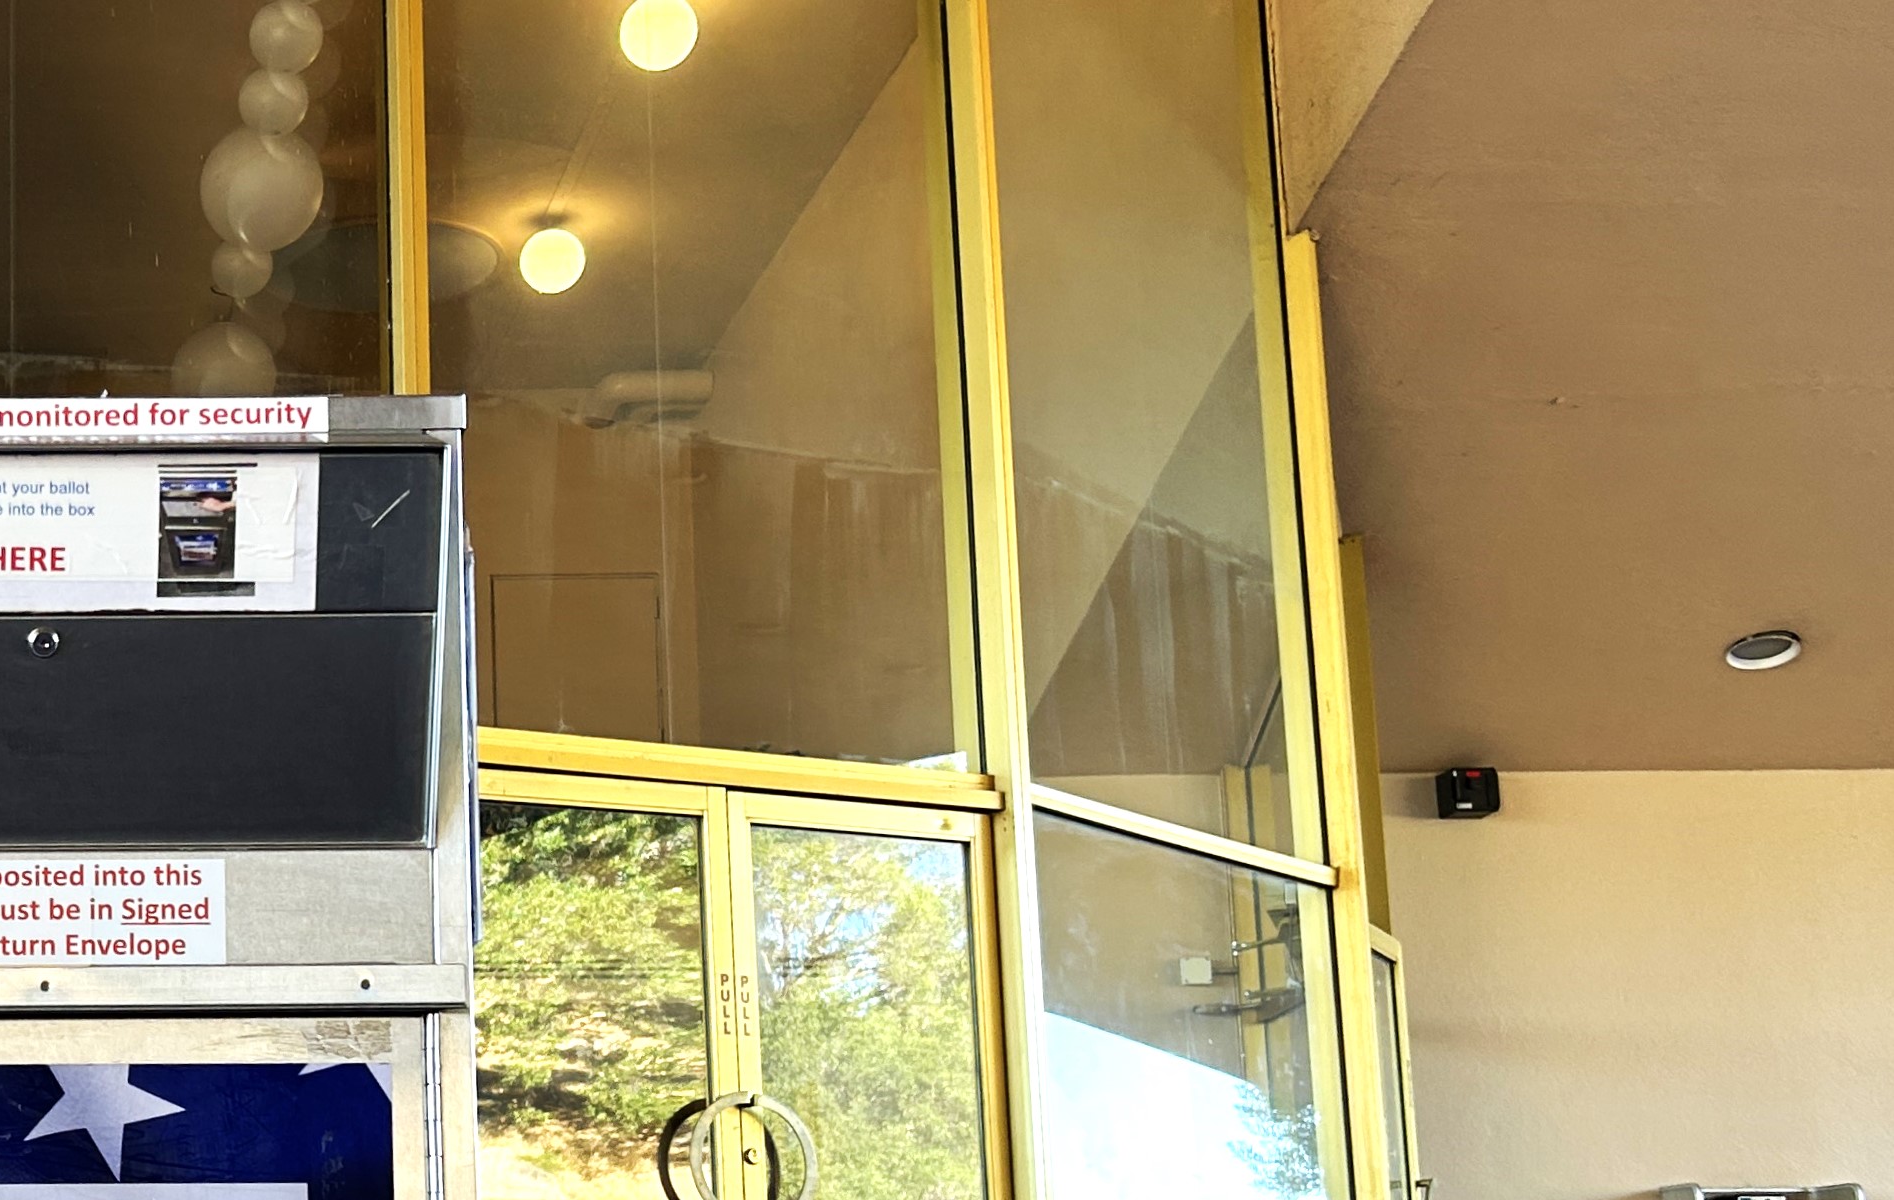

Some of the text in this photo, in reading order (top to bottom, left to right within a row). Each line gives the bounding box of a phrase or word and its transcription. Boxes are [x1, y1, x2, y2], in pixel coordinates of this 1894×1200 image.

[148, 402, 189, 427] for
[198, 402, 312, 430] security
[12, 482, 45, 497] your
[49, 481, 90, 495] ballot
[8, 502, 35, 516] into
[40, 503, 63, 516] the
[68, 503, 96, 516] box
[93, 864, 146, 886] into
[153, 863, 203, 886] this
[49, 898, 81, 920] be
[89, 898, 114, 920] in
[120, 897, 210, 926] Signed
[65, 933, 187, 960] Envelope
[720, 973, 731, 1035] PULL
[740, 975, 751, 1037] PULL
